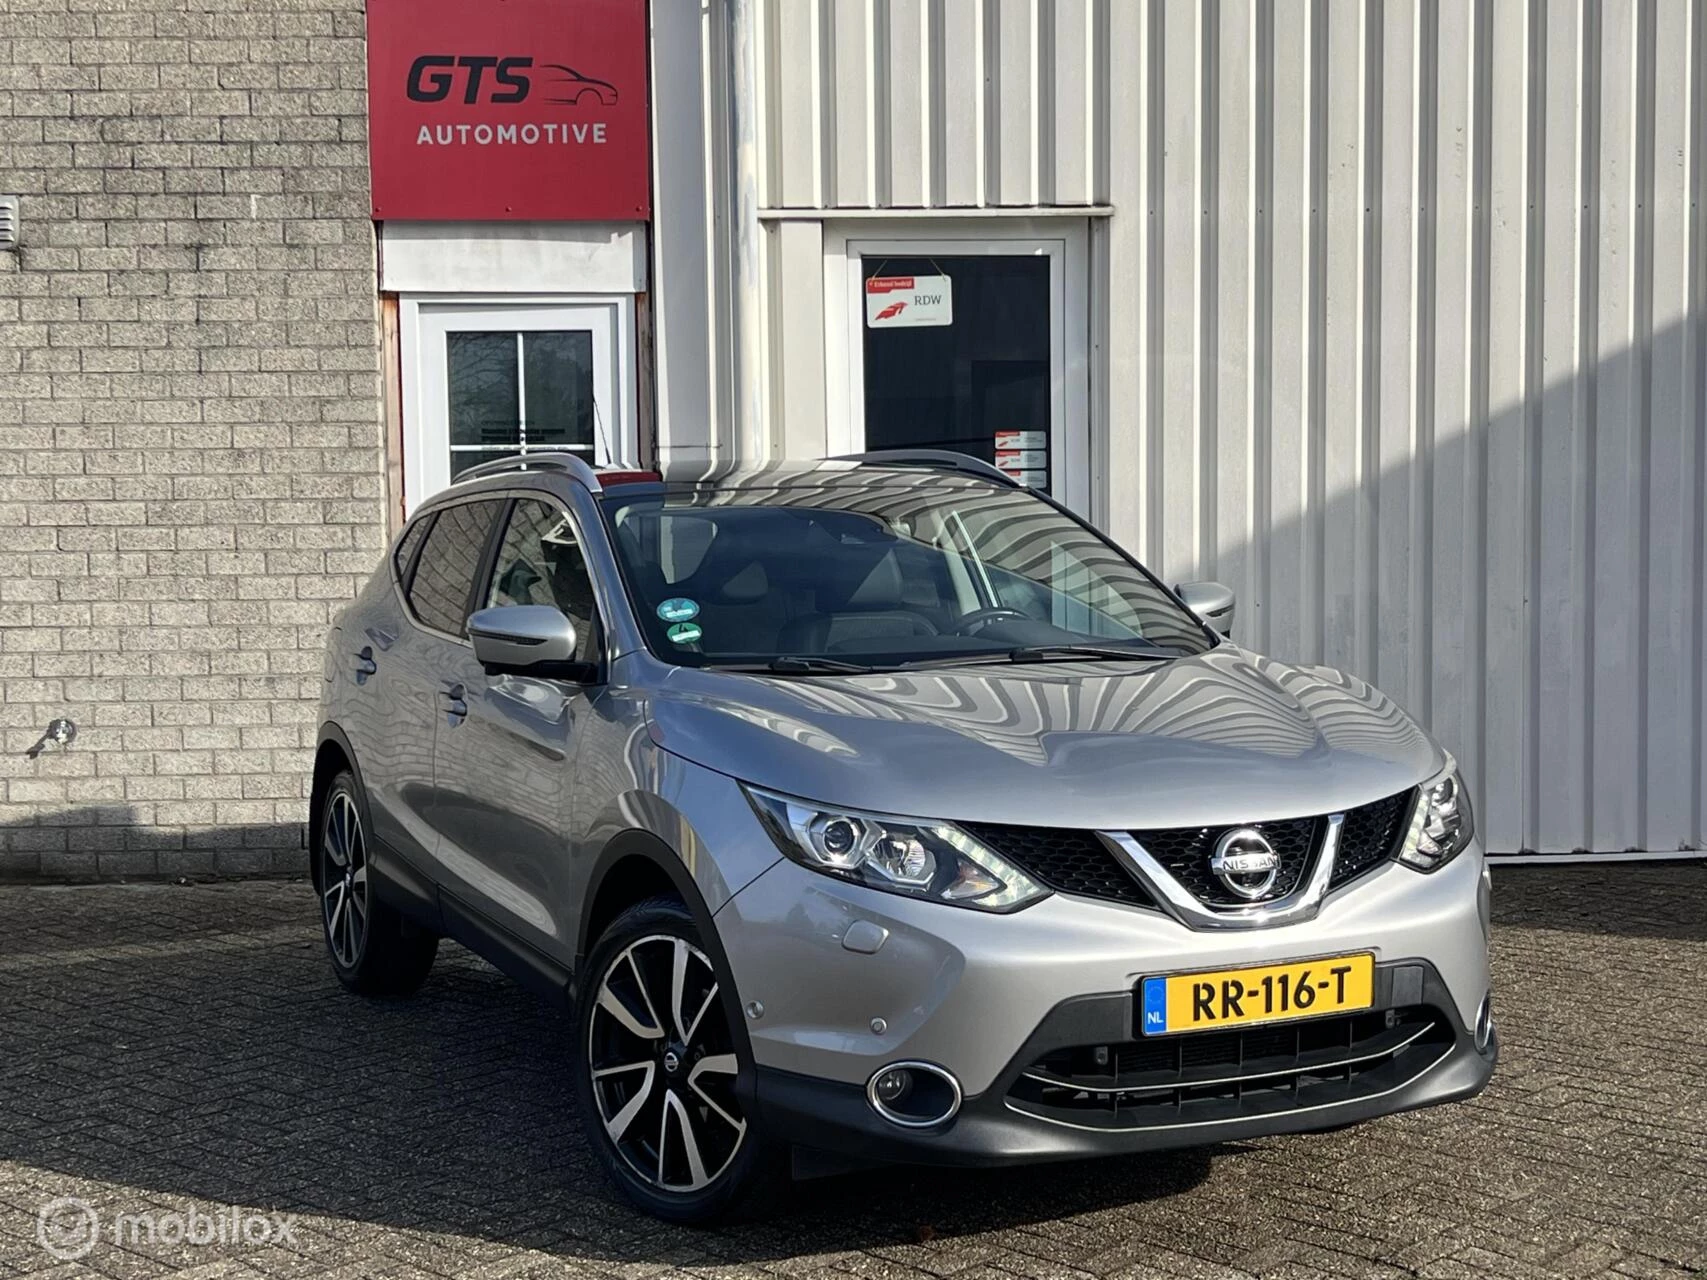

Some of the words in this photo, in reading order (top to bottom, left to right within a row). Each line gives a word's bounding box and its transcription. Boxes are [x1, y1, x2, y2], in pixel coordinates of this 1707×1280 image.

[407, 55, 533, 104] GTS
[417, 123, 607, 145] AUTOMOTIVE
[914, 295, 942, 306] RDW
[1193, 966, 1352, 1021] RR-116-T
[1147, 1011, 1163, 1025] NL
